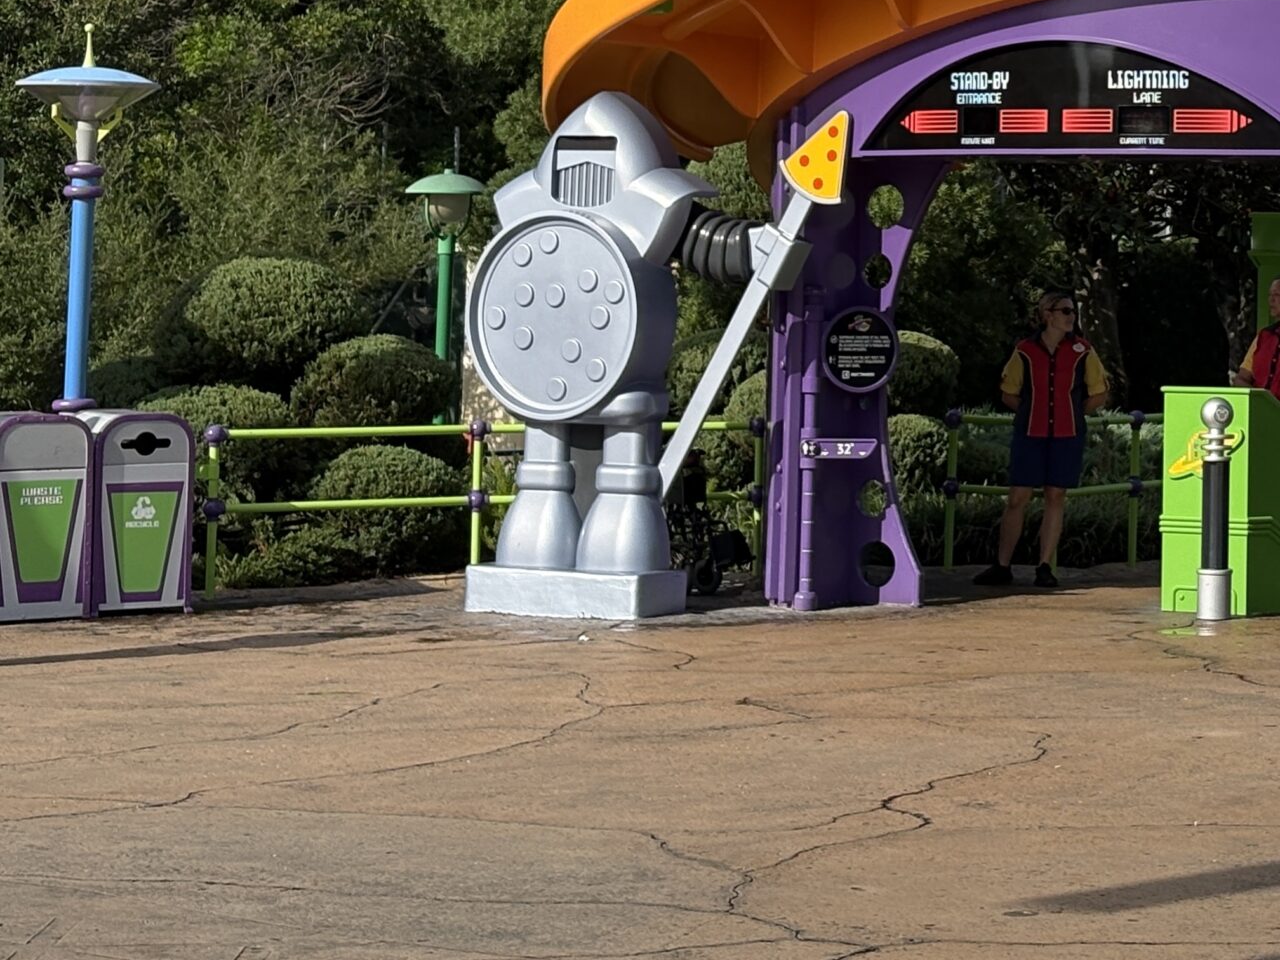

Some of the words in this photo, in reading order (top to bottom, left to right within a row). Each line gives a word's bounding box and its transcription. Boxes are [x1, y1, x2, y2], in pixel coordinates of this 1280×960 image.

[950, 71, 1009, 90] STAND-BY
[1107, 70, 1189, 89] LIGHTNING
[956, 92, 1002, 104] ENTRANCE
[1133, 92, 1162, 103] LANE
[1119, 137, 1147, 145] CURRENT
[22, 486, 62, 496] WASTE
[20, 496, 63, 506] PLEASE
[125, 520, 160, 528] RECYCLE
